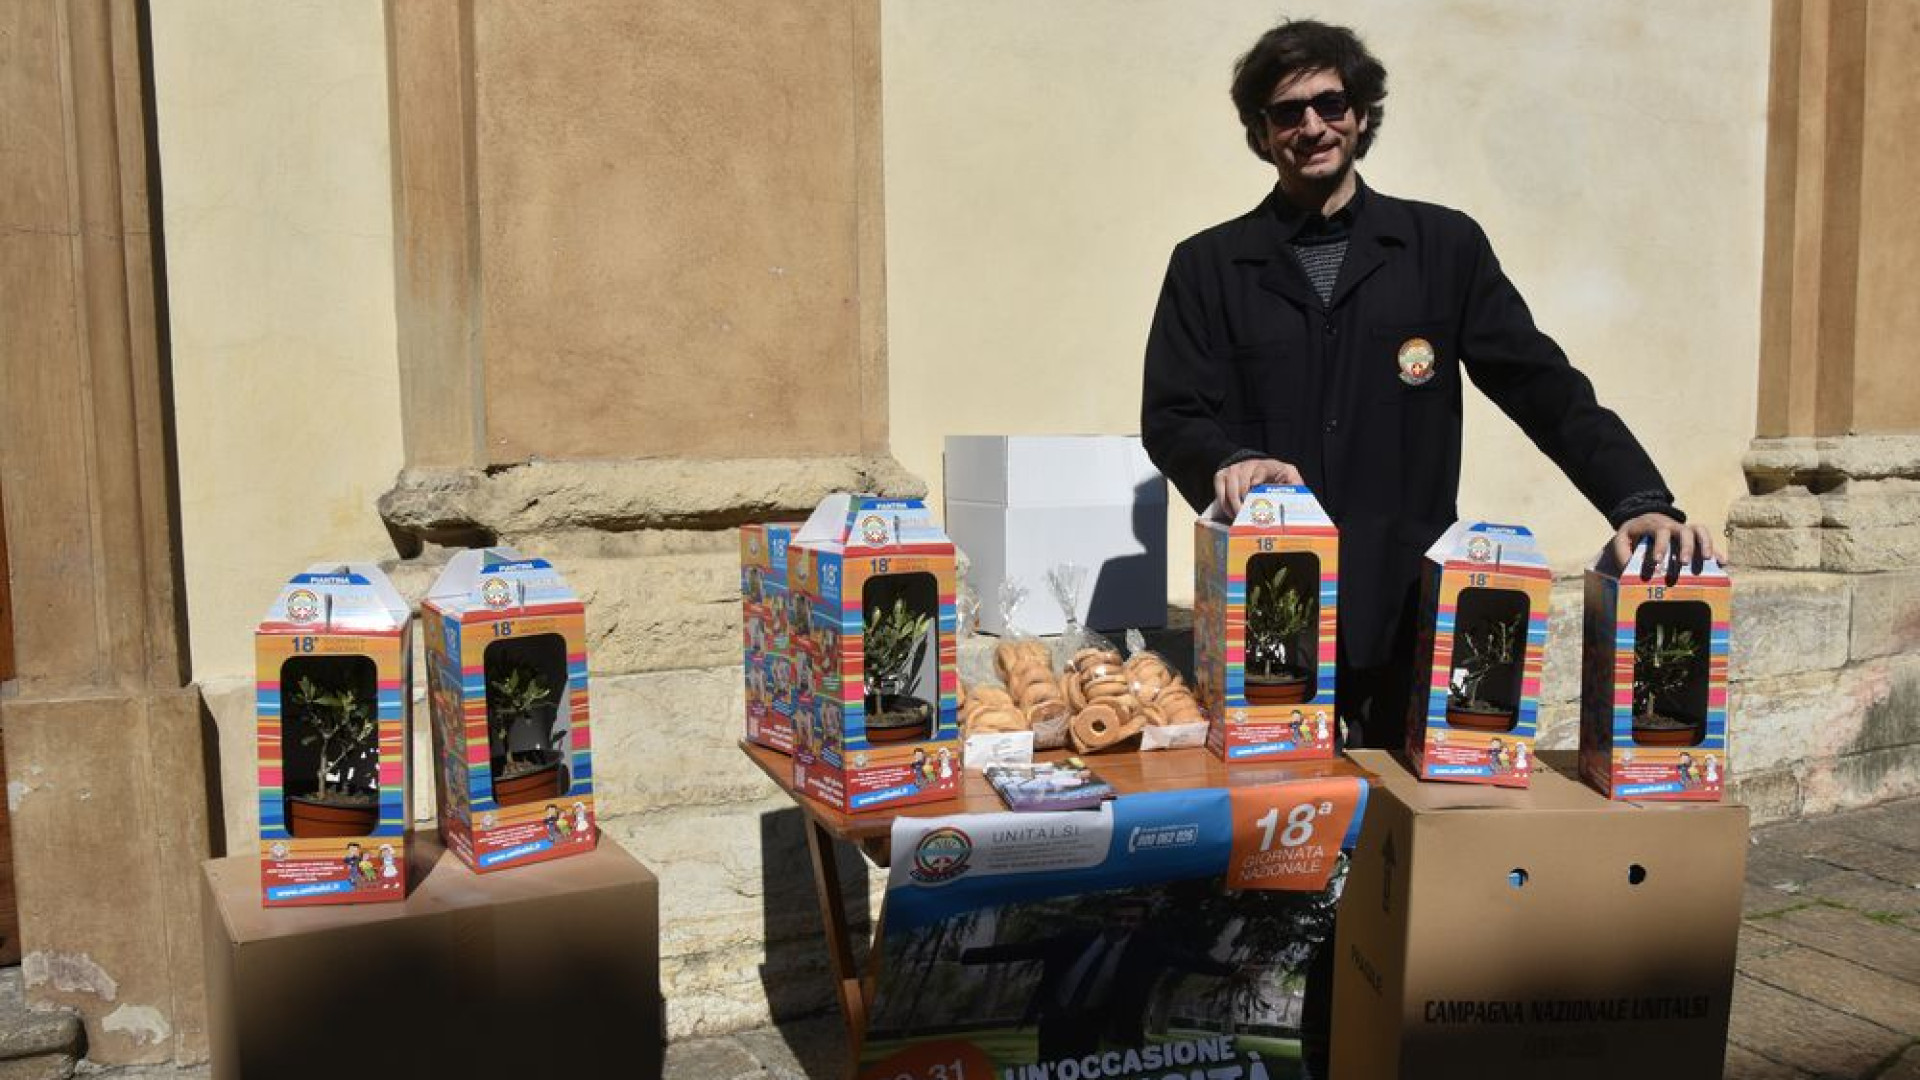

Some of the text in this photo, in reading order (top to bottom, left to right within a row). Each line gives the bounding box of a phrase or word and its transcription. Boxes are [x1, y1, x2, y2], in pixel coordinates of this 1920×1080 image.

[991, 824, 1080, 843] UNITALSI
[1241, 845, 1324, 868] GIORNATA
[1239, 860, 1322, 881] NAZIONALE
[1424, 999, 1523, 1024] CAMPAGNA
[1531, 997, 1628, 1022] NAZIONALE
[1005, 1035, 1236, 1080] UN'OCCASIONE
